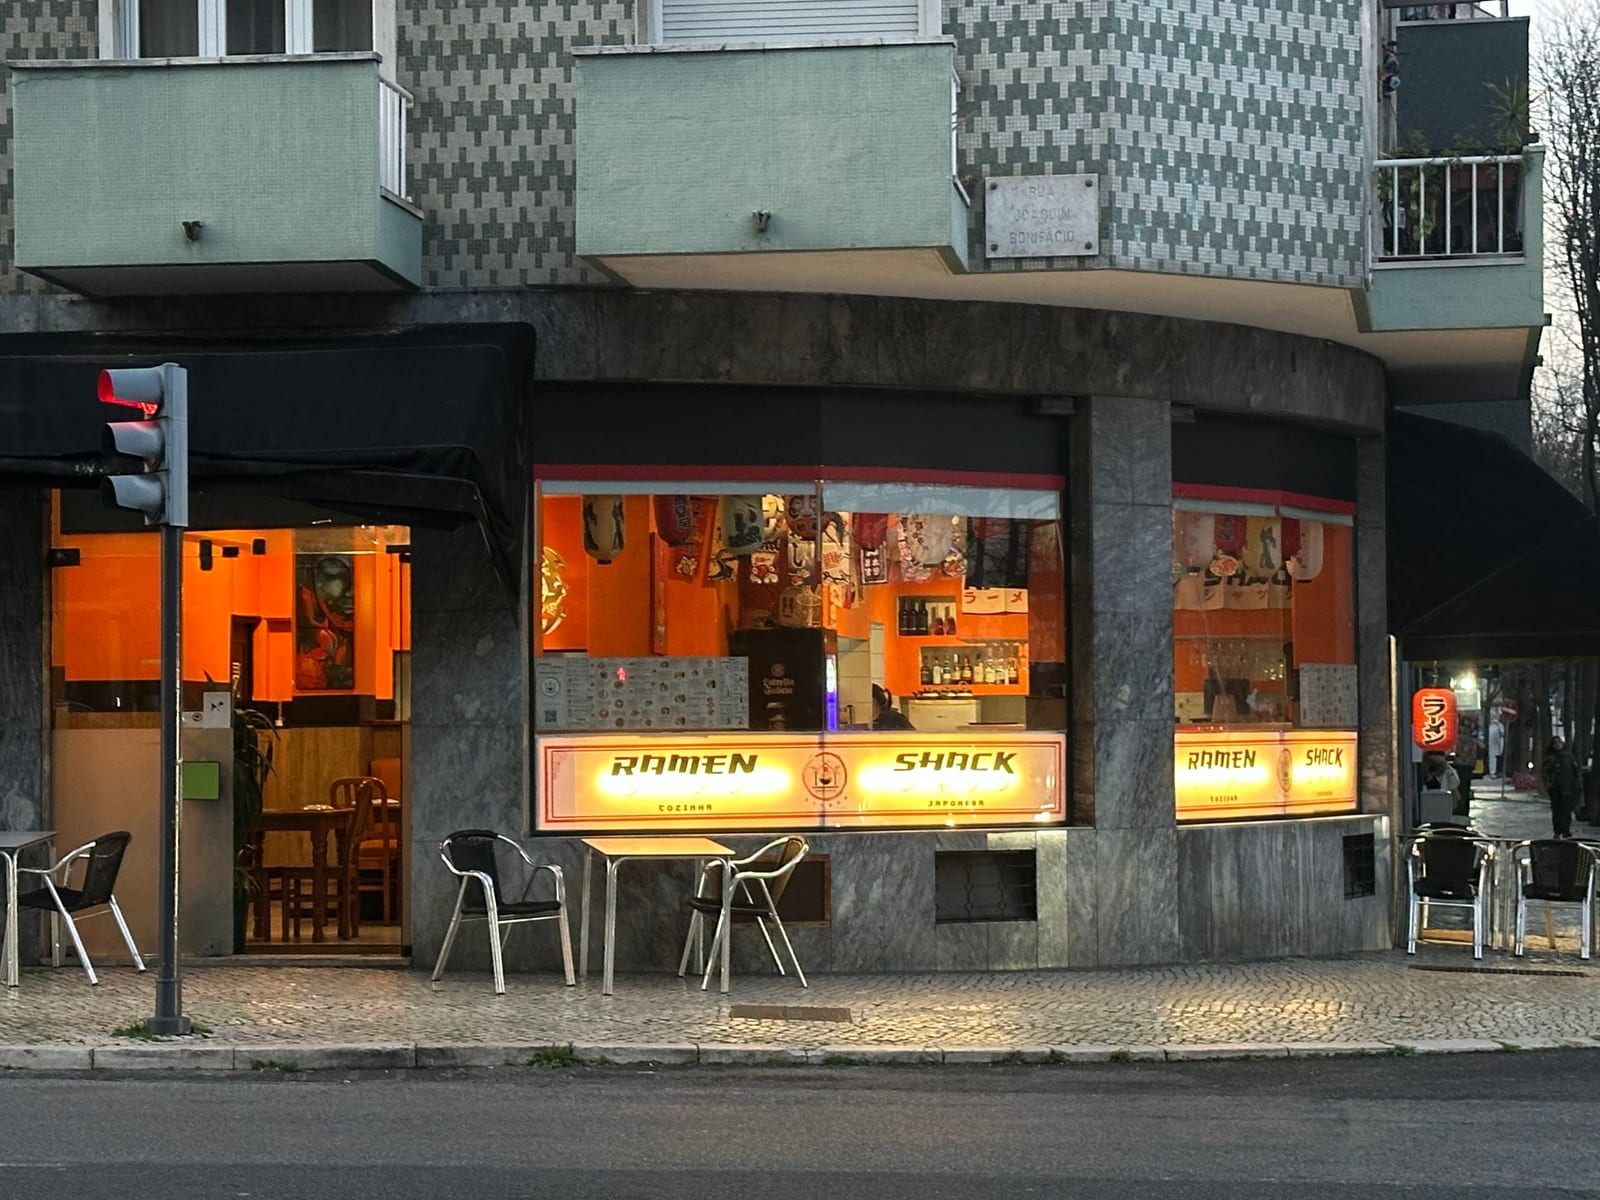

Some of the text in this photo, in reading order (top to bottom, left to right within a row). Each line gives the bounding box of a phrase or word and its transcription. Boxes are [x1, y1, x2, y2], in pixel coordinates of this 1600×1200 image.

[1028, 186, 1054, 198] RUA
[1422, 697, 1447, 746] ラーメン
[612, 751, 1018, 776] RAMEN SHACK
[1188, 747, 1343, 770] RAMEN SHACK
[658, 799, 984, 812] COZINHA JAPONESA
